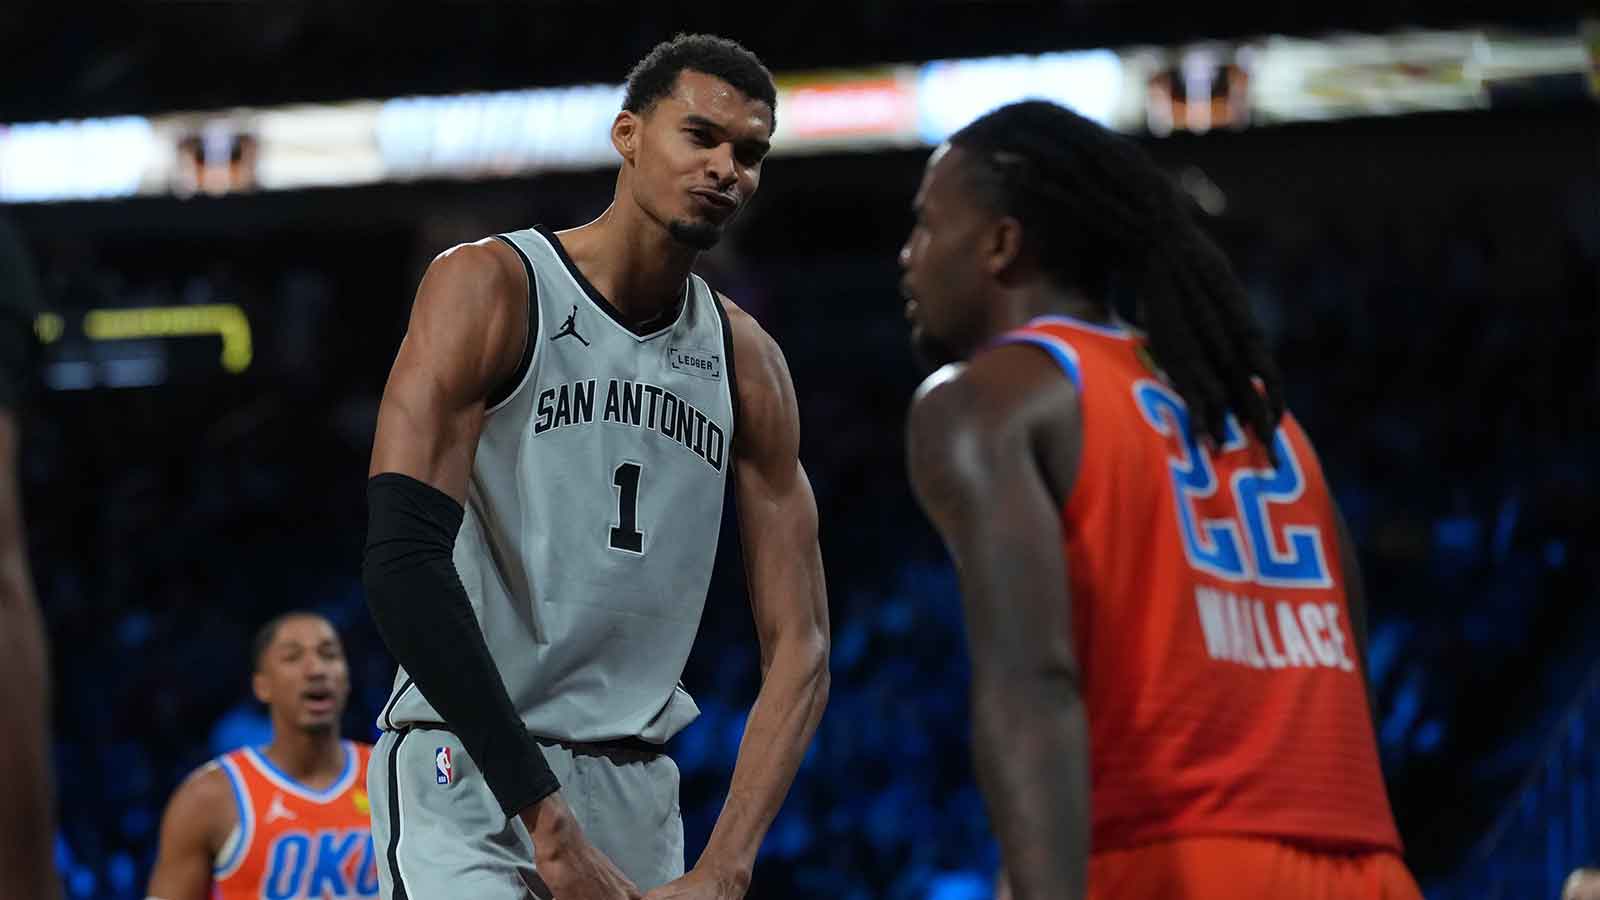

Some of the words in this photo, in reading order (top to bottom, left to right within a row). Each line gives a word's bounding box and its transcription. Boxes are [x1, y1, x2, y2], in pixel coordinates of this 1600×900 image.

[678, 354, 713, 371] LEDGER
[534, 378, 597, 436] SAN
[602, 378, 725, 473] ANTONIO
[608, 461, 644, 555] 1
[1132, 378, 1333, 587] 22
